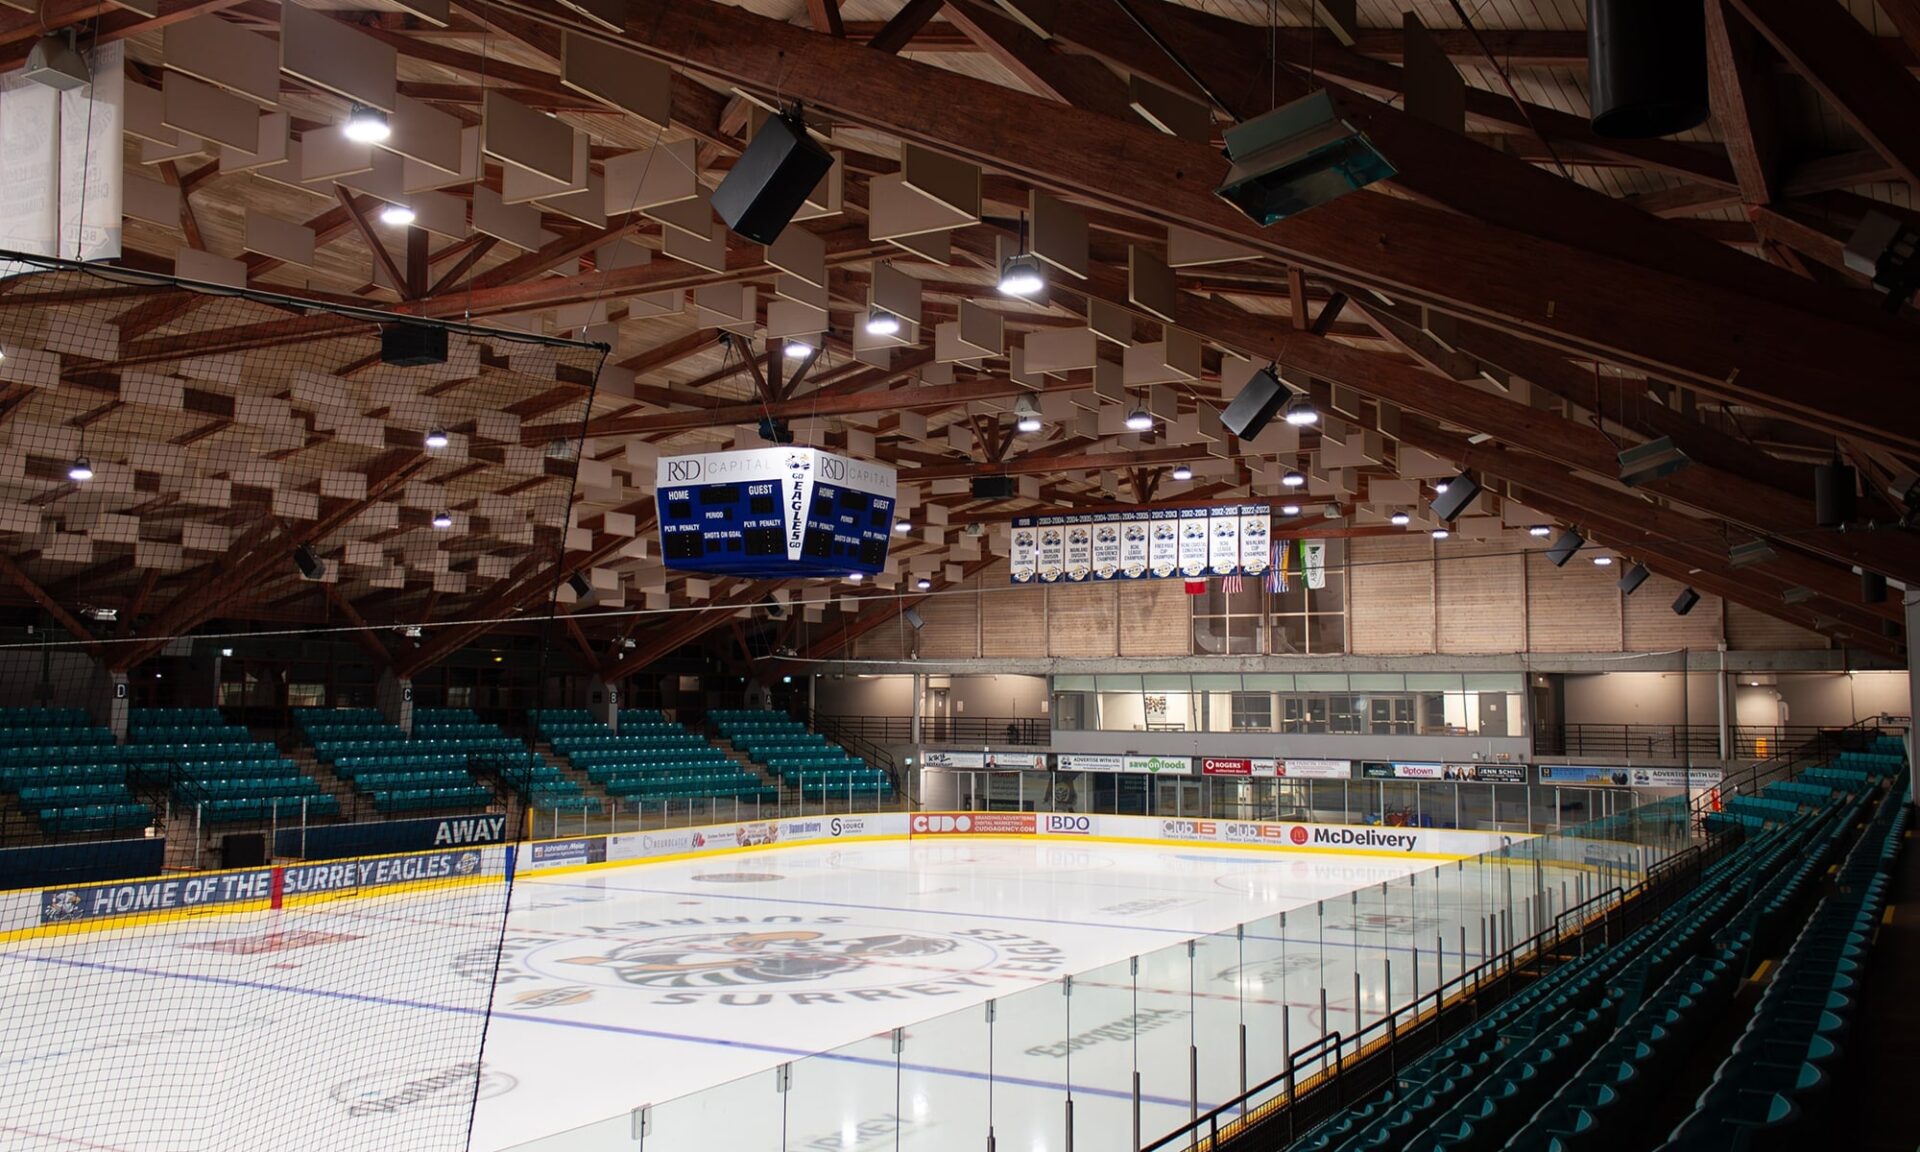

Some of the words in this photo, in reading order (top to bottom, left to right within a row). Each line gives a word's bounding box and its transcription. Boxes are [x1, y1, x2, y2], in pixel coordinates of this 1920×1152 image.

[668, 459, 700, 481] RSD
[708, 459, 772, 474] CAPITAL
[821, 457, 845, 481] RSD
[850, 468, 891, 488] CAPITAL
[668, 490, 689, 501] HOME
[748, 484, 773, 495] GUEST
[818, 487, 835, 499] HOME
[873, 498, 890, 510] GUEST
[1241, 505, 1270, 515] 2022-2023
[706, 511, 723, 519] PERIOD
[791, 481, 804, 541] EAGLES
[1122, 511, 1148, 520] 2004-2005
[1152, 510, 1177, 519] 2012-2013
[1181, 509, 1207, 517] 2012-2013
[1211, 506, 1238, 515] 2012-2013
[759, 519, 781, 528] PENALTY
[704, 531, 720, 539] SHOTS
[728, 530, 742, 538] GOAL
[117, 684, 126, 698] D
[404, 689, 412, 701] C
[1652, 770, 1687, 778] ADVERTIS
[843, 822, 864, 830] SOURCE
[914, 815, 971, 832] CUDO
[1052, 816, 1089, 831] BDO
[434, 817, 505, 846] AWAY
[1314, 828, 1417, 852] McDelivery
[544, 844, 568, 853] Johnston
[93, 882, 179, 914] HOME
[184, 876, 218, 904] OF
[222, 872, 270, 900] THE
[284, 863, 374, 891] SURREY
[374, 853, 450, 883] EAGLES
[951, 928, 1064, 975] EAGLES
[652, 976, 993, 1007] SURREY
